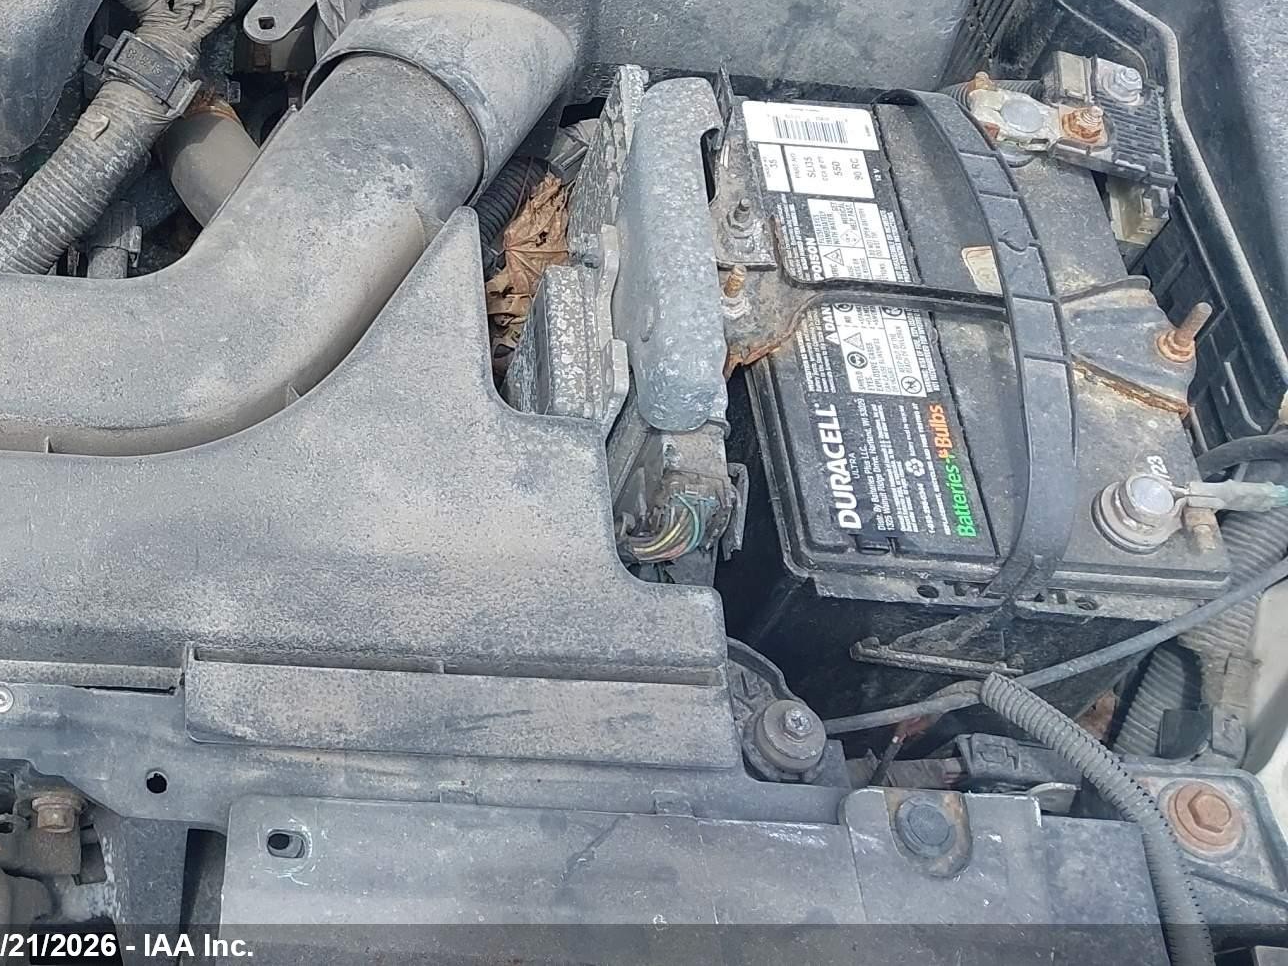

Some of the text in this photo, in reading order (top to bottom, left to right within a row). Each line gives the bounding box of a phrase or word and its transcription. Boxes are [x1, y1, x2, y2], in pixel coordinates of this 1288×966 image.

[832, 161, 842, 176] 550
[850, 158, 860, 169] RC
[875, 173, 882, 182] 12
[805, 237, 824, 281] POISON
[928, 405, 952, 448] Bulbs
[814, 403, 861, 529] DURACELL
[849, 452, 861, 479] ULTRA
[864, 460, 872, 474] Plus
[873, 504, 883, 512] By
